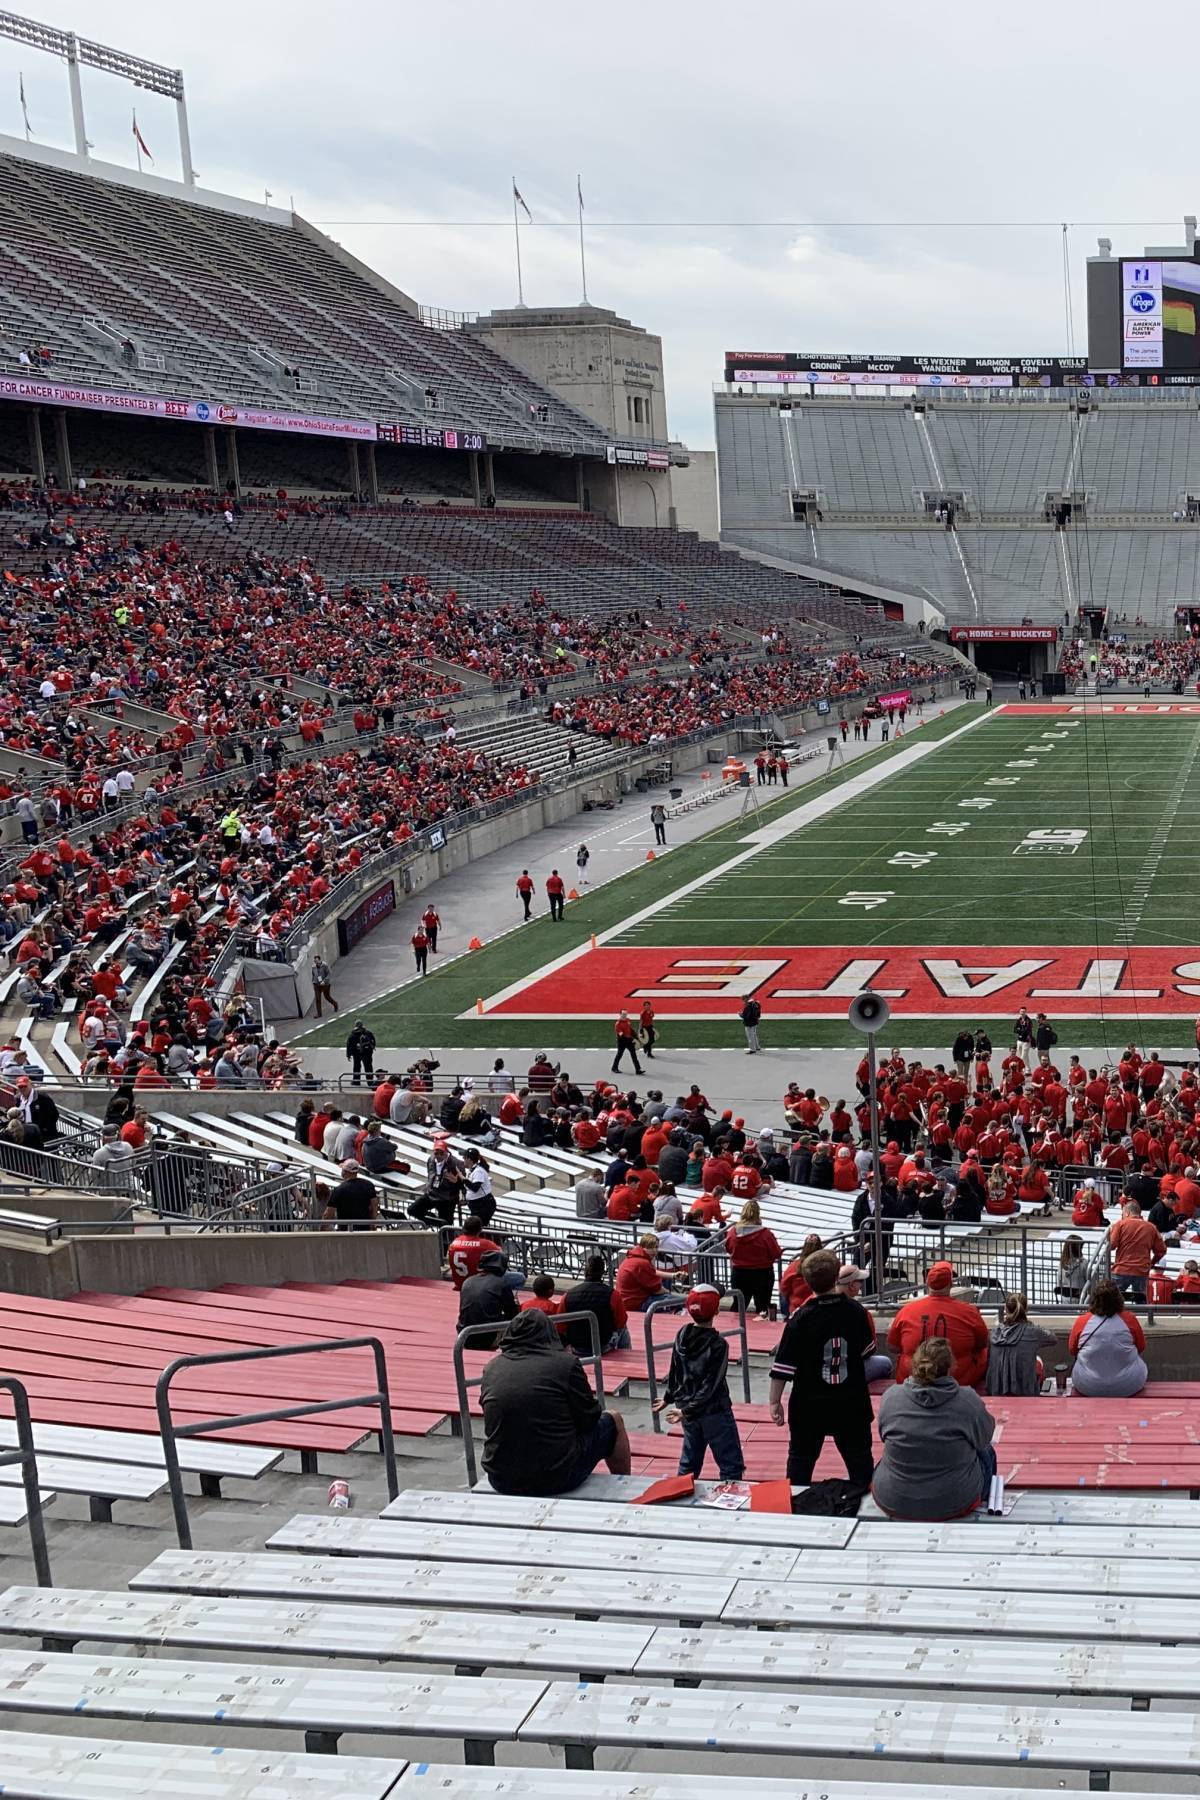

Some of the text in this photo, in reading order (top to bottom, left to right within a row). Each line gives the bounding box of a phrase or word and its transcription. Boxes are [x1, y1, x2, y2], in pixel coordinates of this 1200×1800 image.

[1133, 295, 1153, 311] Kroger
[810, 362, 842, 370] CRONIN
[1152, 375, 1158, 384] 0
[0, 382, 158, 411] FOR CANCER FUNDRAISER PRESENTED BY
[164, 401, 190, 415] BEEF
[464, 434, 482, 449] 2:00
[969, 630, 994, 638] HOME
[1011, 630, 1052, 638] BUCKEYES
[82, 794, 94, 803] 47
[837, 891, 896, 906] 10
[733, 1174, 748, 1190] 42
[454, 1251, 468, 1277] 5
